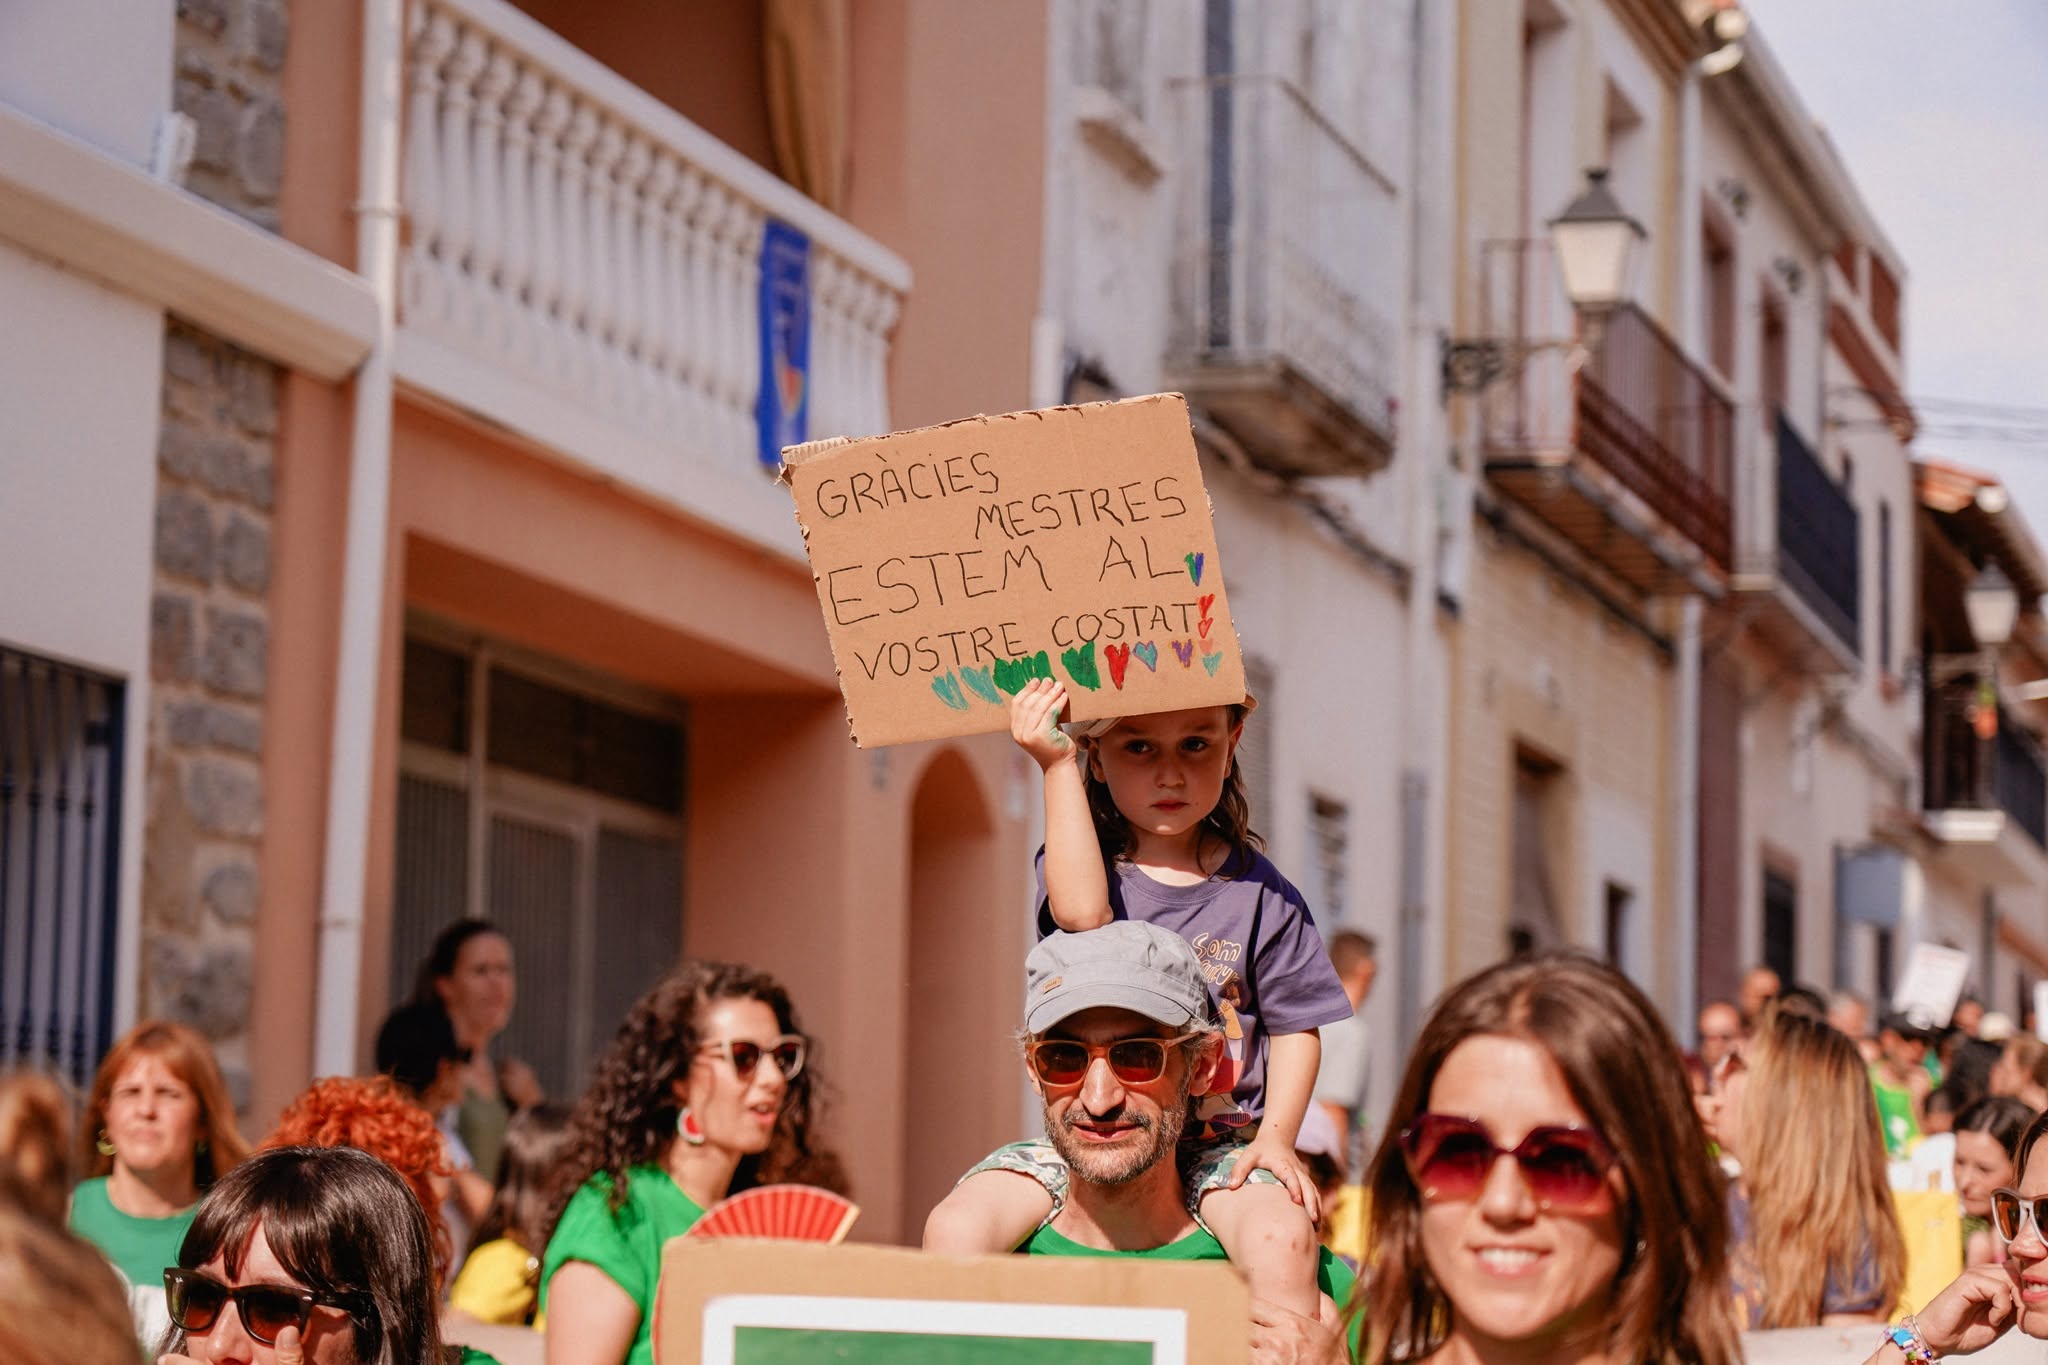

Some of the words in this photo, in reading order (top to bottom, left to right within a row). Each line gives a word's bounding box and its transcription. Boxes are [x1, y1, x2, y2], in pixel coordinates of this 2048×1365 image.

[975, 476, 1187, 540] MESTRES
[828, 544, 1052, 626] ESTEM
[1099, 535, 1185, 582] AL
[854, 622, 1029, 681] VOSTRE
[1051, 602, 1198, 647] COSTAT
[1192, 932, 1242, 962] Som
